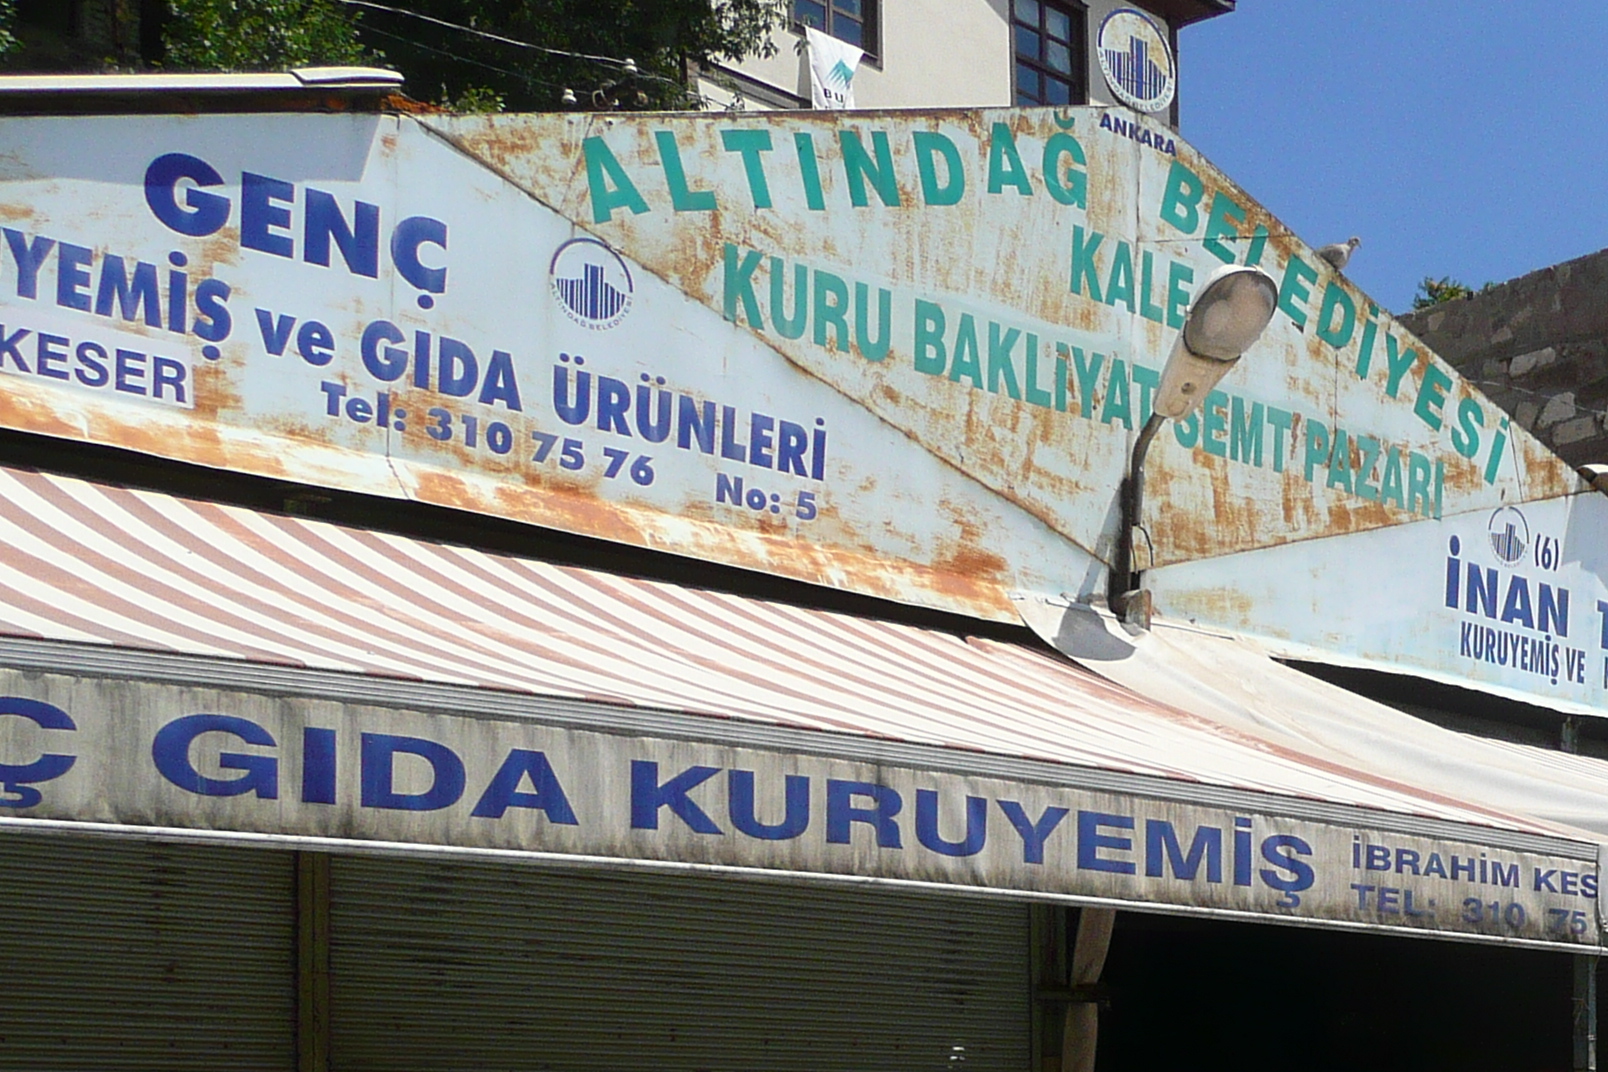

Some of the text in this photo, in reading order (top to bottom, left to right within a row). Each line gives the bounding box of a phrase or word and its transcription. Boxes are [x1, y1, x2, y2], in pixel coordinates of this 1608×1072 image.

[582, 110, 1087, 224] ALTINDAĞ
[1100, 113, 1177, 157] ANKARA
[144, 152, 448, 309] GENÇ
[1071, 225, 1193, 330] KALE
[0, 322, 188, 403] KESER
[2, 226, 826, 482] YEMİŞ ve GIDA ÜRÜNLERİ
[723, 243, 892, 363] KURU
[914, 298, 1160, 431] BAKLİYAT
[1304, 418, 1444, 520] PAZARI
[321, 381, 818, 521] Tel: 310 75 76 No: 5
[1445, 535, 1569, 638] İNAN
[1535, 533, 1559, 572] (6)
[1460, 621, 1560, 685] KURUYEMİŞ
[1566, 646, 1586, 684] VE
[151, 713, 579, 827] GIDA
[631, 759, 1316, 908] KURUYEMİŞ
[1352, 835, 1519, 888] İBRAHİM
[1350, 883, 1587, 935] TEL: 310 75
